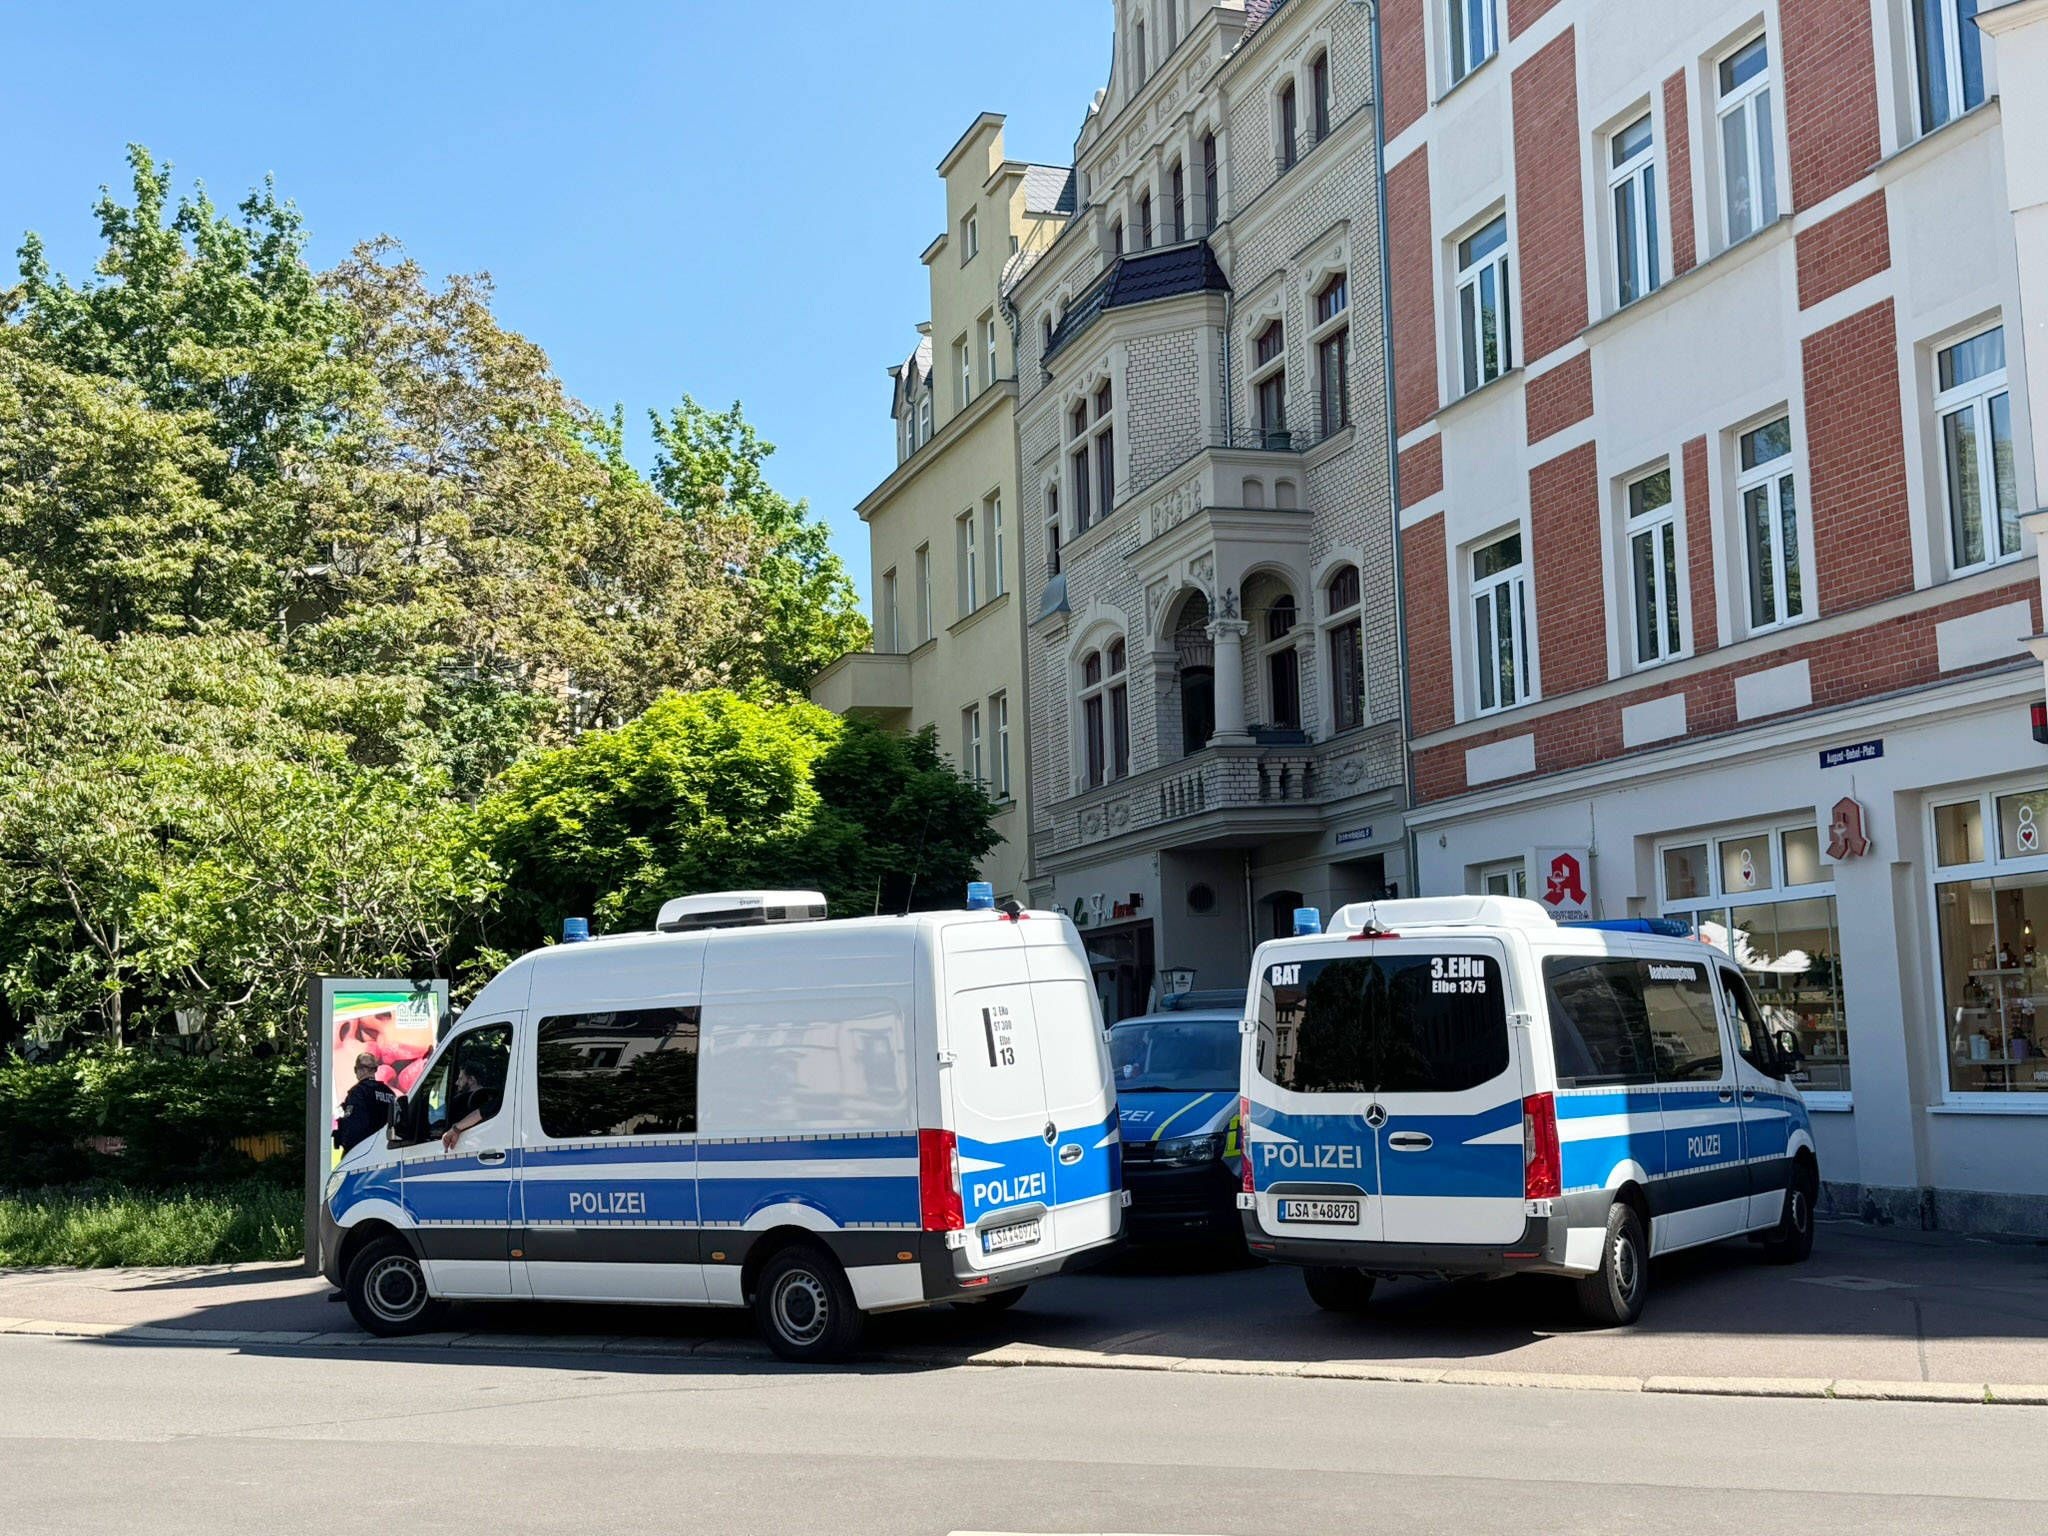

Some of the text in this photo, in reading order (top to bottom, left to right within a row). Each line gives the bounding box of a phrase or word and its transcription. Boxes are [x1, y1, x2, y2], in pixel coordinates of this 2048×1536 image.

[1271, 964, 1301, 986] BAT
[1431, 957, 1485, 979] 3.EHu
[1431, 980, 1486, 994] Elbe 13/5
[1000, 1047, 1015, 1066] 13
[1263, 1144, 1362, 1169] POLIZEI
[1687, 1133, 1721, 1160] POLIZEI
[973, 1171, 1047, 1208] POLIZEI
[569, 1192, 646, 1214] POLIZEI
[1287, 1203, 1356, 1219] LSA 48878
